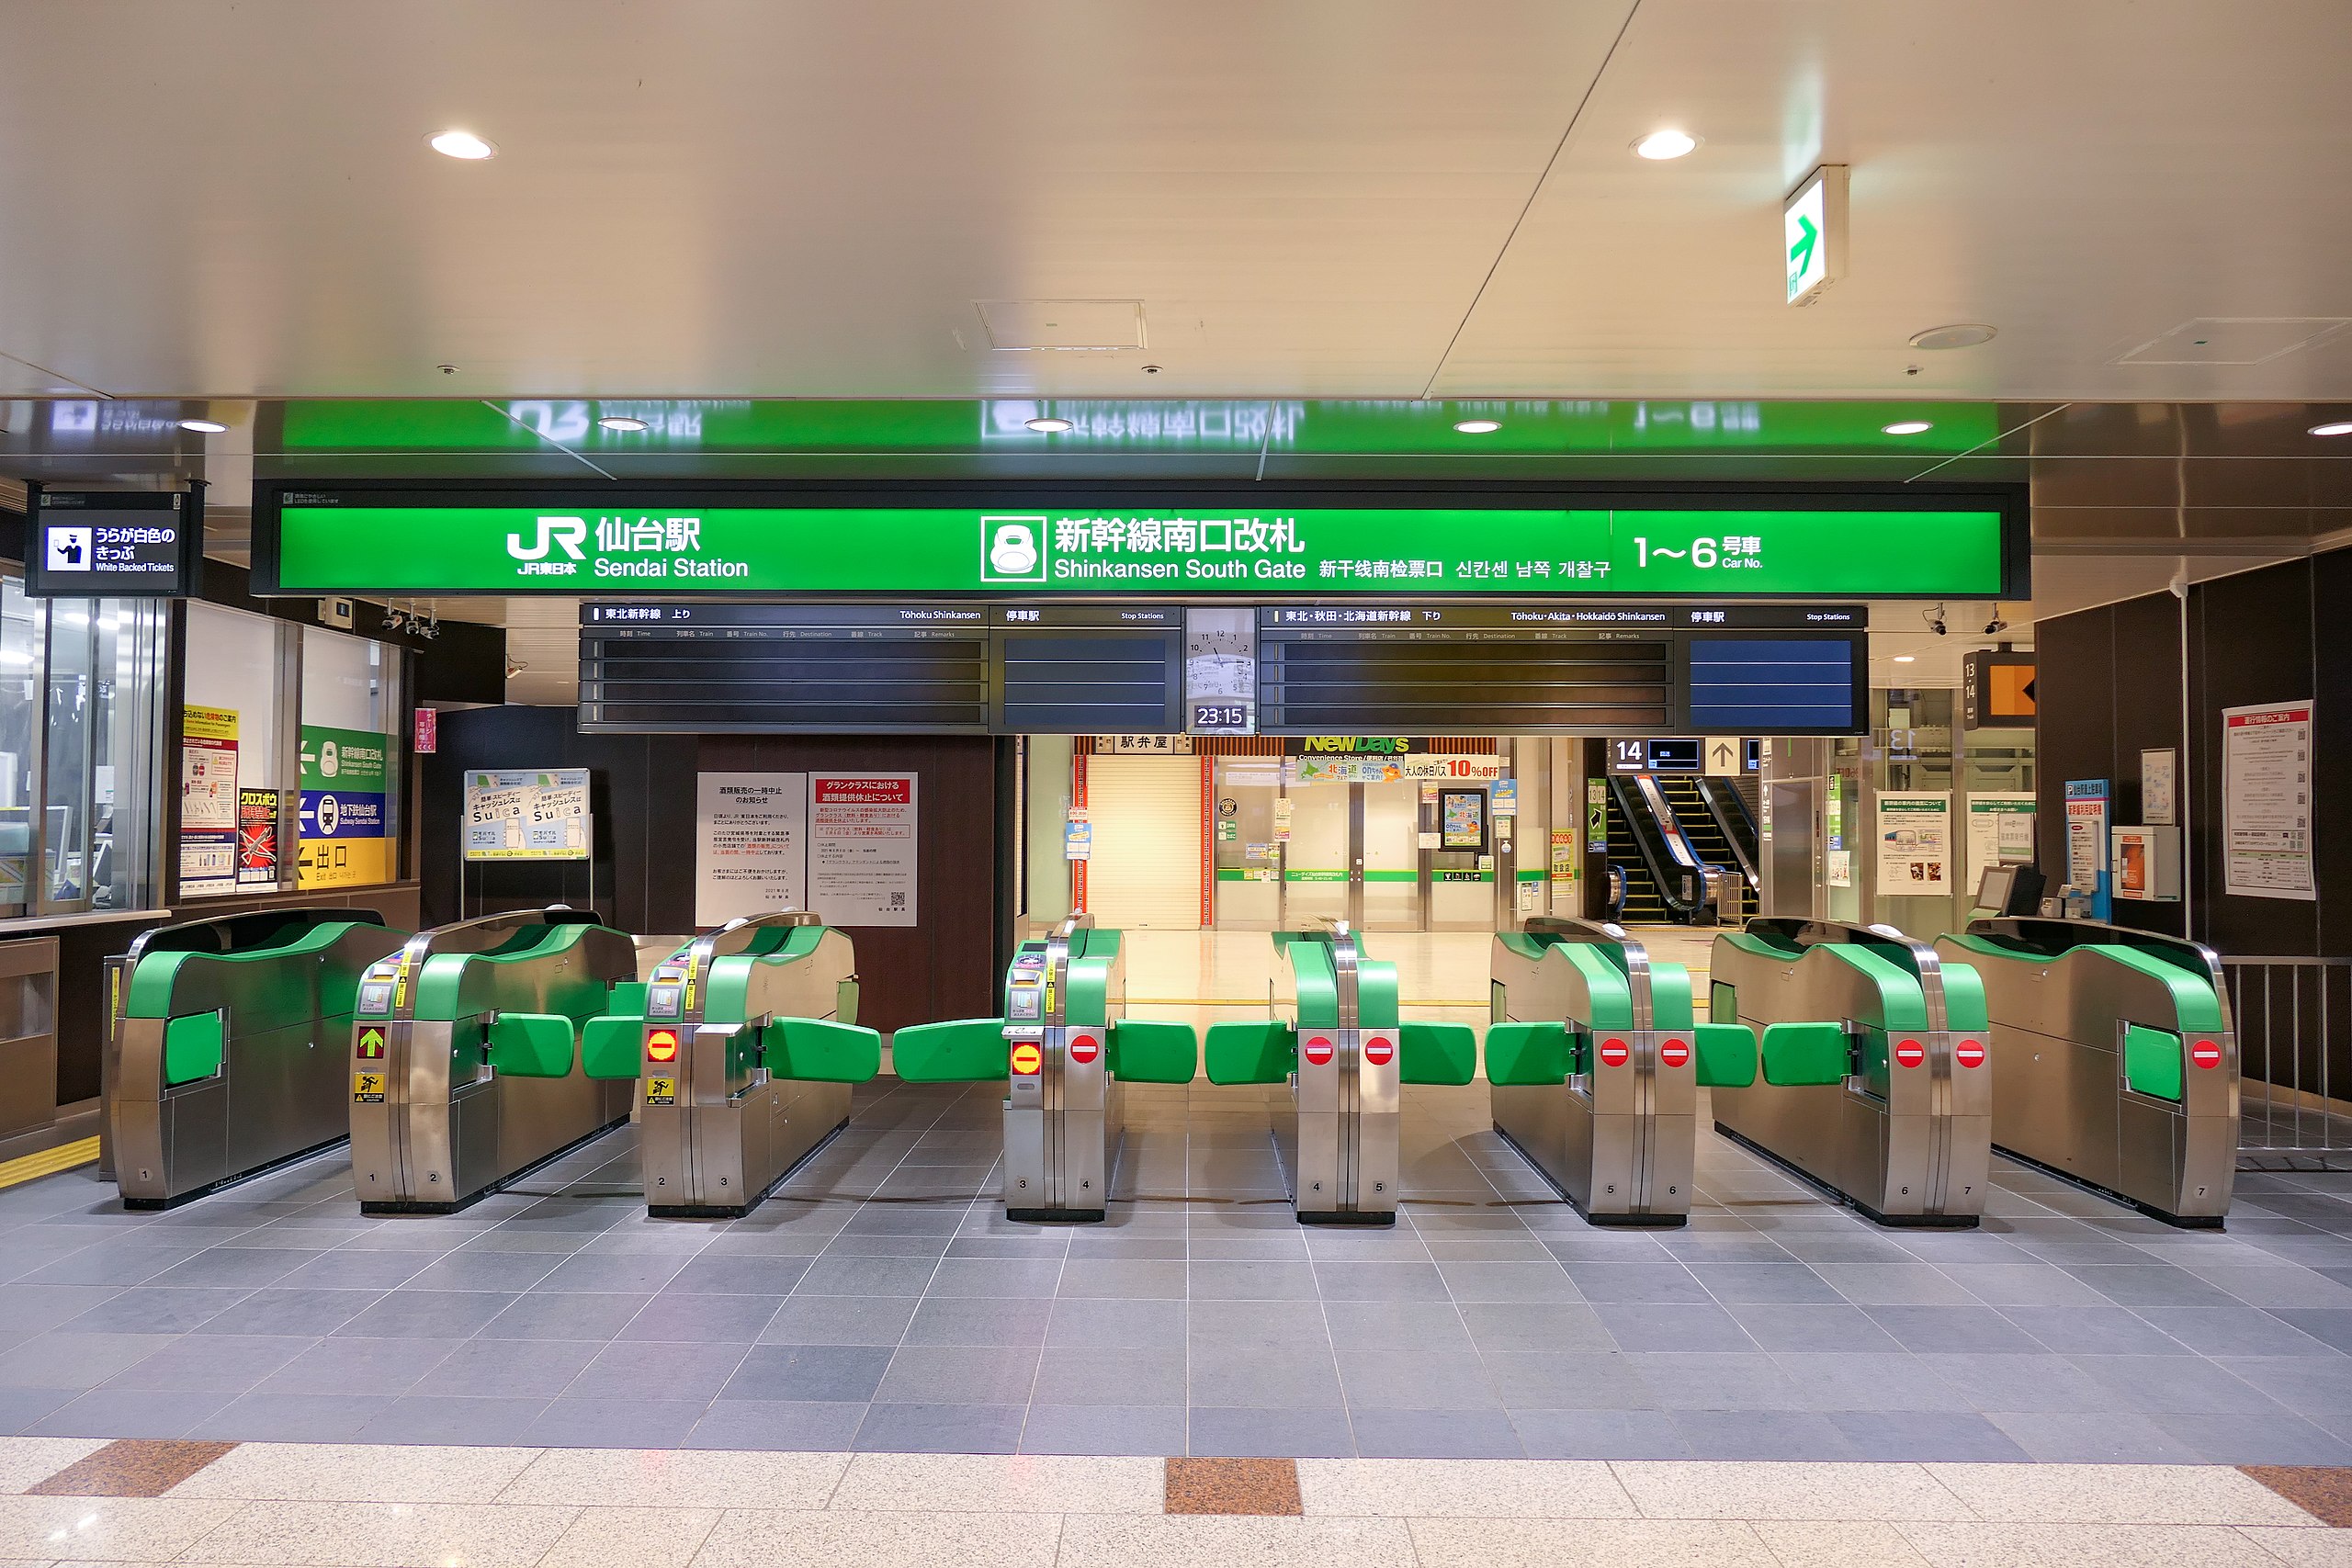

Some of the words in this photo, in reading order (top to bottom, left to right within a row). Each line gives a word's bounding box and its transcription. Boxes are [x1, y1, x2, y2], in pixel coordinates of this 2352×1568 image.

[96, 527, 175, 544] うらが白色の
[507, 516, 587, 560] JR
[594, 516, 701, 551] 仙台駅
[1054, 517, 1306, 553] 新幹線南口改札
[1721, 536, 1761, 556] 号車
[96, 546, 135, 560] きっぷ
[96, 562, 118, 572] White
[119, 562, 146, 572] Backed
[148, 562, 175, 572] Tickets
[517, 562, 577, 576] JR東日本
[594, 558, 667, 577] Sendai
[673, 558, 749, 577] Station
[1054, 559, 1179, 580] Shinkansen
[1185, 559, 1249, 580] South
[1254, 559, 1306, 580] Gate
[1318, 560, 1443, 580] 新干线南检票口
[1455, 560, 1509, 580] 신칸센
[1516, 560, 1552, 580] 남쪽
[1558, 560, 1611, 580] 개찰구
[1722, 558, 1742, 570] Car
[1744, 558, 1763, 570] No.
[605, 608, 662, 620] 東北新幹線
[672, 609, 691, 619] 上り
[899, 610, 932, 619] Tōhoku
[933, 610, 980, 619] Shinkansen
[1006, 610, 1040, 622] 停車駅
[1121, 612, 1138, 621] Stop
[1139, 612, 1164, 620] Stations
[1285, 610, 1411, 622] 東北・秋田・北海道新幹線
[1422, 611, 1441, 621] 下り
[1617, 611, 1665, 621] Shinkansen
[1690, 611, 1725, 624] 停車駅
[1806, 613, 1826, 622] Stop
[1828, 613, 1850, 621] Stations
[1966, 663, 1975, 677] 13
[1966, 685, 1975, 698] 14
[1197, 708, 1243, 724] 23:15
[1120, 736, 1168, 749] 駅弁屋
[1304, 736, 1409, 754] NewDays
[342, 746, 383, 761] 新幹線南口改札
[1616, 740, 1643, 761] 14
[1329, 763, 1357, 775] 北海道
[1406, 766, 1446, 777] 大人の休日パス
[719, 786, 783, 795] 酒類販売の一時中止
[826, 781, 899, 790] グランクラスにおける
[241, 792, 277, 807] クロスボウ
[821, 794, 903, 802] 酒類提供休止について
[1589, 790, 1597, 801] 13
[1599, 790, 1605, 801] 14
[473, 797, 521, 810] キャッシュレスは
[533, 796, 582, 809] キャッシュレスは
[340, 804, 377, 816] 地下鉄仙台駅
[473, 807, 521, 823] Suica
[534, 806, 582, 822] Suica
[340, 818, 355, 826] Subway
[317, 845, 346, 869] 出口
[141, 1170, 148, 1179] 1
[369, 1174, 375, 1182] 1
[430, 1174, 437, 1182] 2
[720, 1178, 728, 1186] 3
[1019, 1180, 1026, 1189] 3
[1082, 1180, 1090, 1189] 4
[1313, 1183, 1320, 1191] 4
[1375, 1183, 1383, 1191] 5
[1607, 1185, 1614, 1194] 5
[1668, 1186, 1676, 1194] 6
[2198, 1188, 2205, 1196] 7
